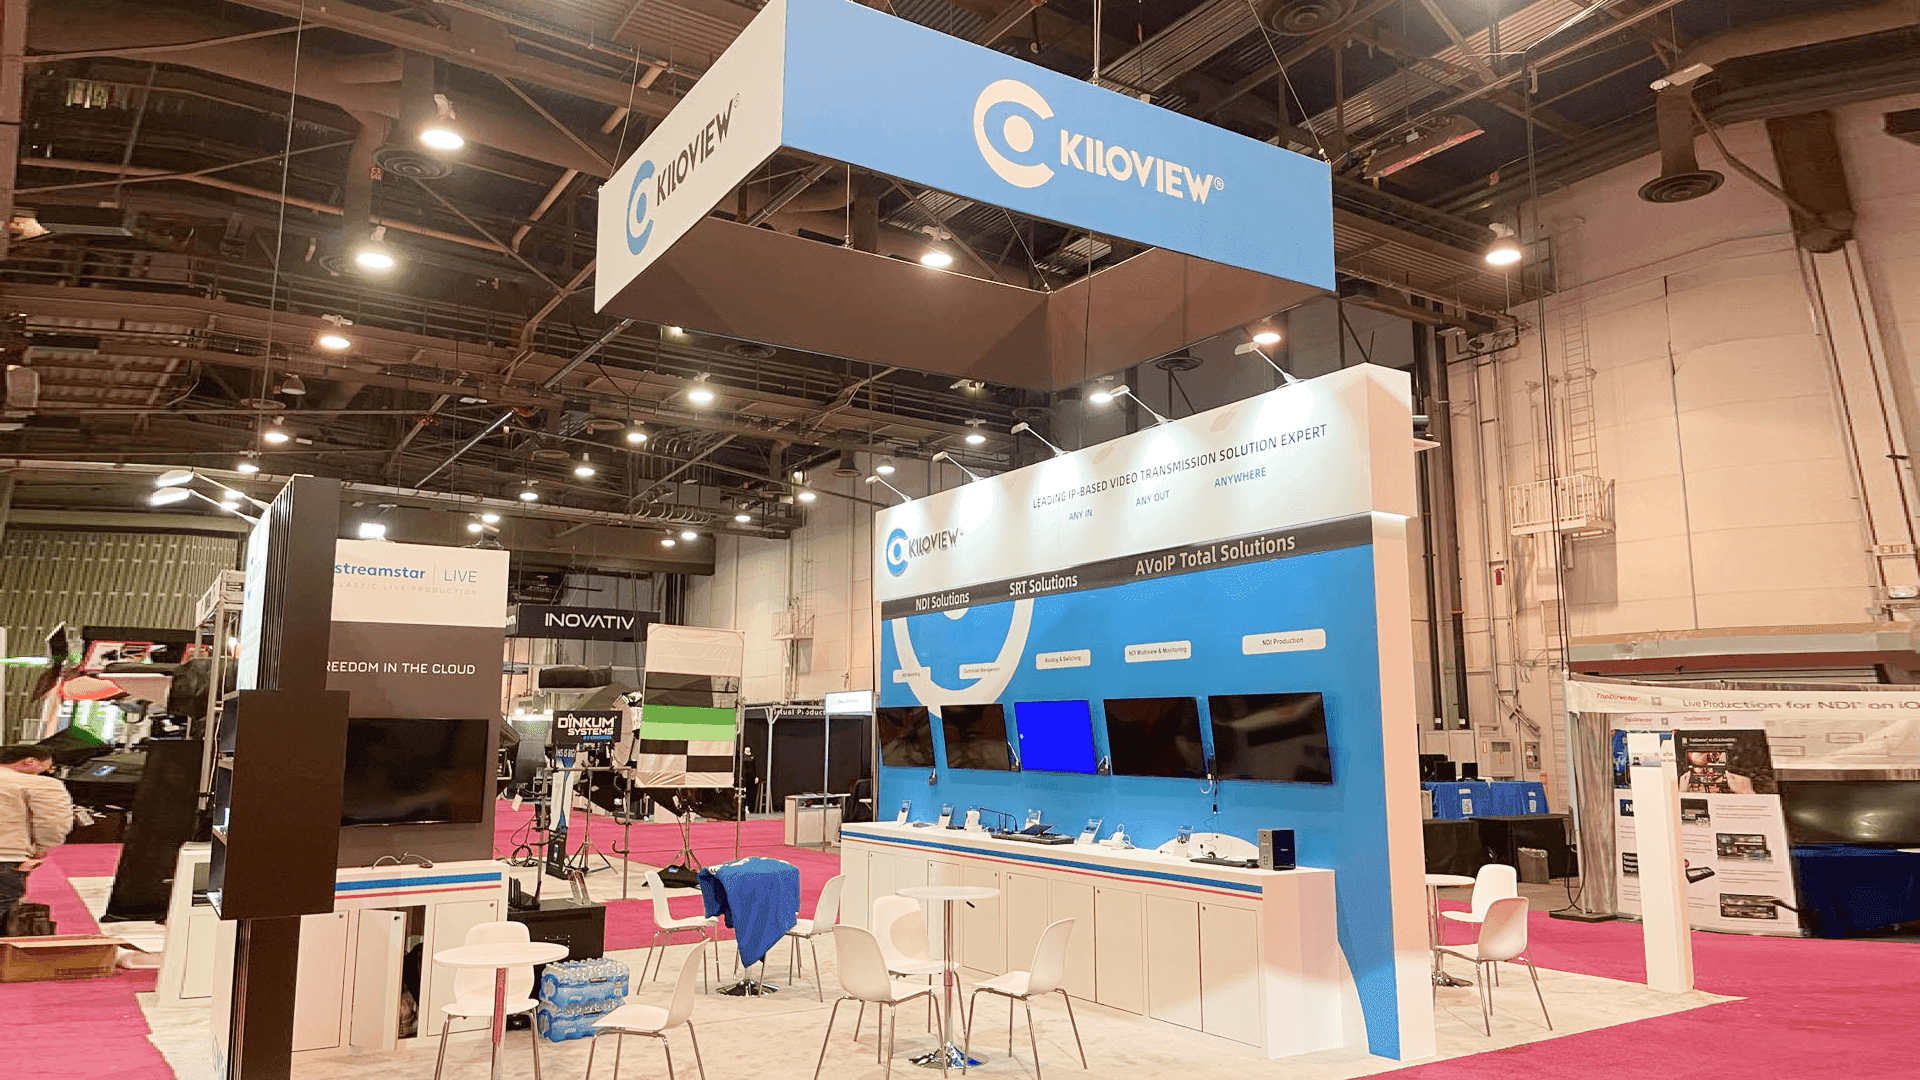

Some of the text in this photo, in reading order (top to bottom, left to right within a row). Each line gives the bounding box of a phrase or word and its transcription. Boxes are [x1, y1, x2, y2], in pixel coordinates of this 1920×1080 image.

[1033, 424, 1327, 508] LEADING IP-BASED VIDEO TRANSMISSION SOLUTION EXPERT
[1214, 467, 1267, 488] ANYWHERE
[1136, 490, 1170, 507] ANY OUT
[1069, 508, 1093, 520] ANY IN
[1135, 535, 1296, 576] AVoIP Total Solutions
[334, 562, 478, 583] streamstar LIVE
[337, 582, 378, 590] LASTIC
[1009, 574, 1078, 596] SRT Solutions
[915, 592, 970, 611] NDI Solutions
[545, 612, 635, 630] INOVATIV
[326, 661, 476, 675] REEDOM IN THE CLOUD
[1683, 699, 1701, 708] Live
[1703, 700, 1782, 709] Production
[1786, 700, 1811, 709] for
[557, 713, 615, 729] DINKUM
[568, 727, 614, 736] SYSTEMS
